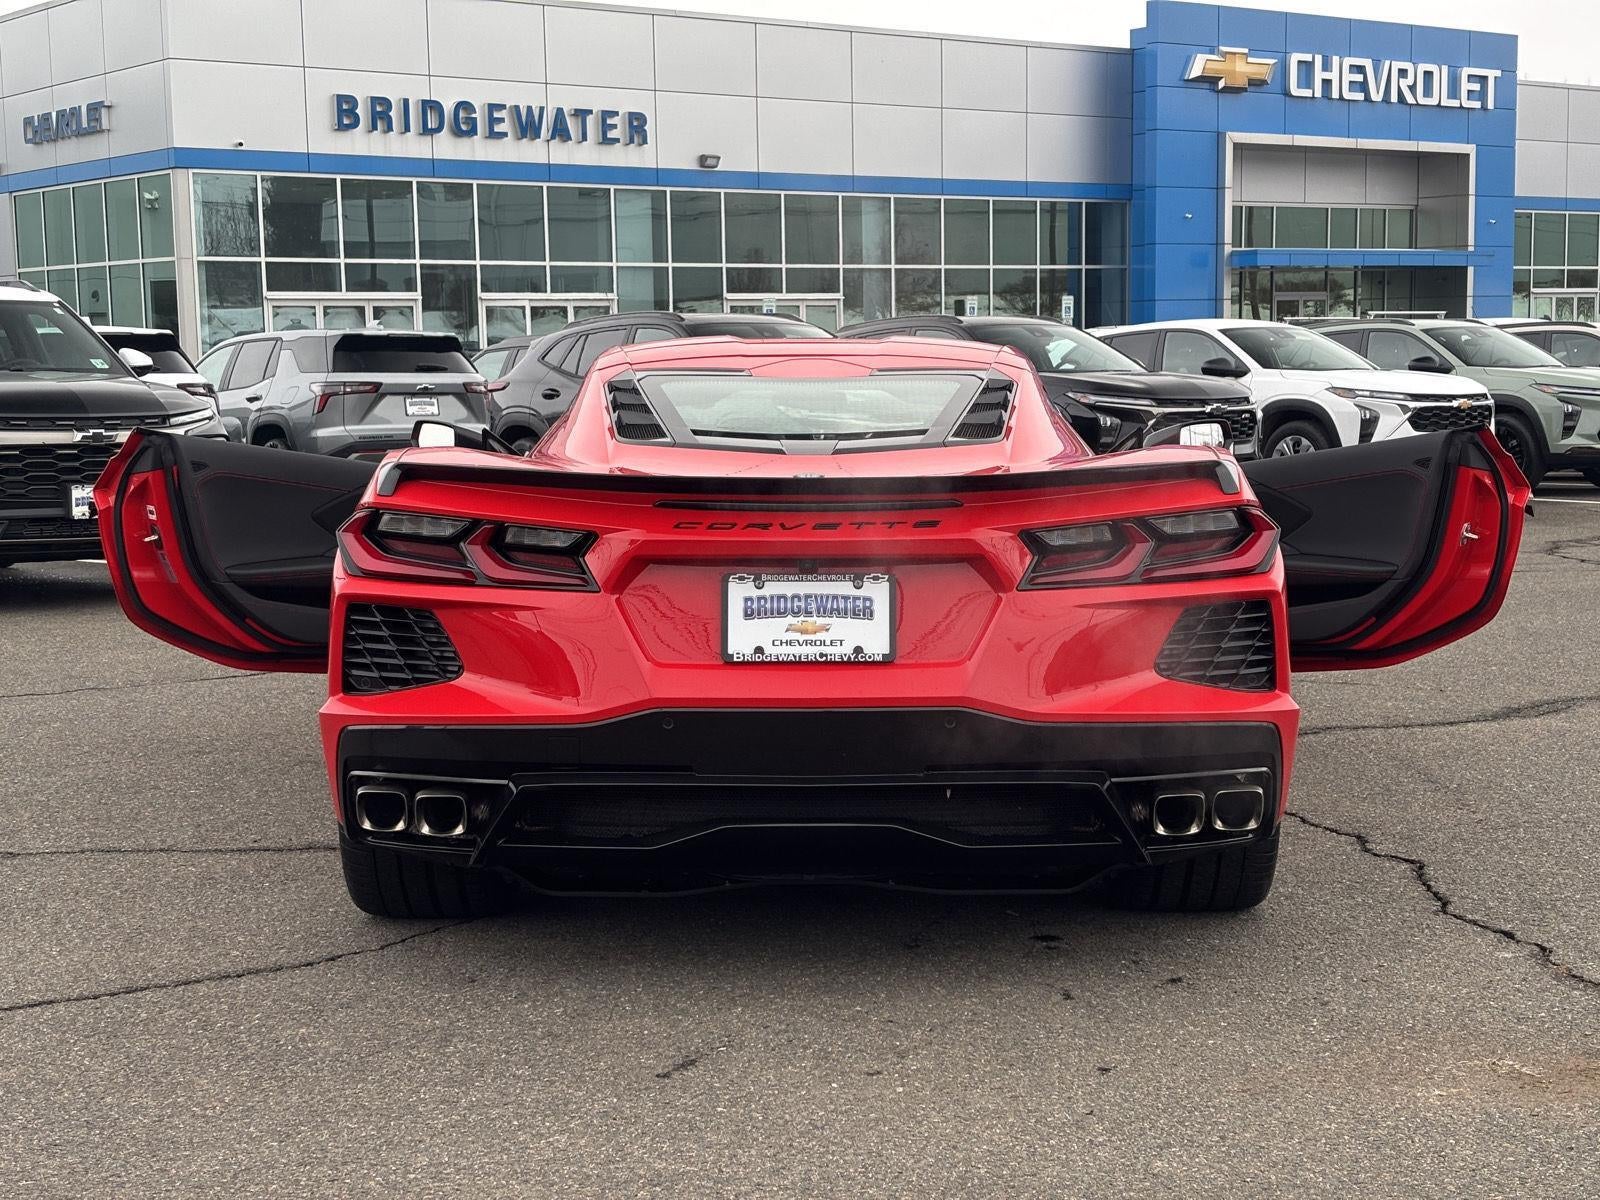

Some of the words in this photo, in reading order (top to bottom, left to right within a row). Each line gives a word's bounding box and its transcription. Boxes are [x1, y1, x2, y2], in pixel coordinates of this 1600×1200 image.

[1289, 52, 1502, 110] CHEVROLET
[23, 100, 109, 144] CHEVROLET
[333, 93, 649, 146] BRIDGEWATER
[672, 519, 943, 531] CORVETTE
[743, 592, 875, 620] BRIDGEWATER
[772, 639, 845, 647] CHEVROLET
